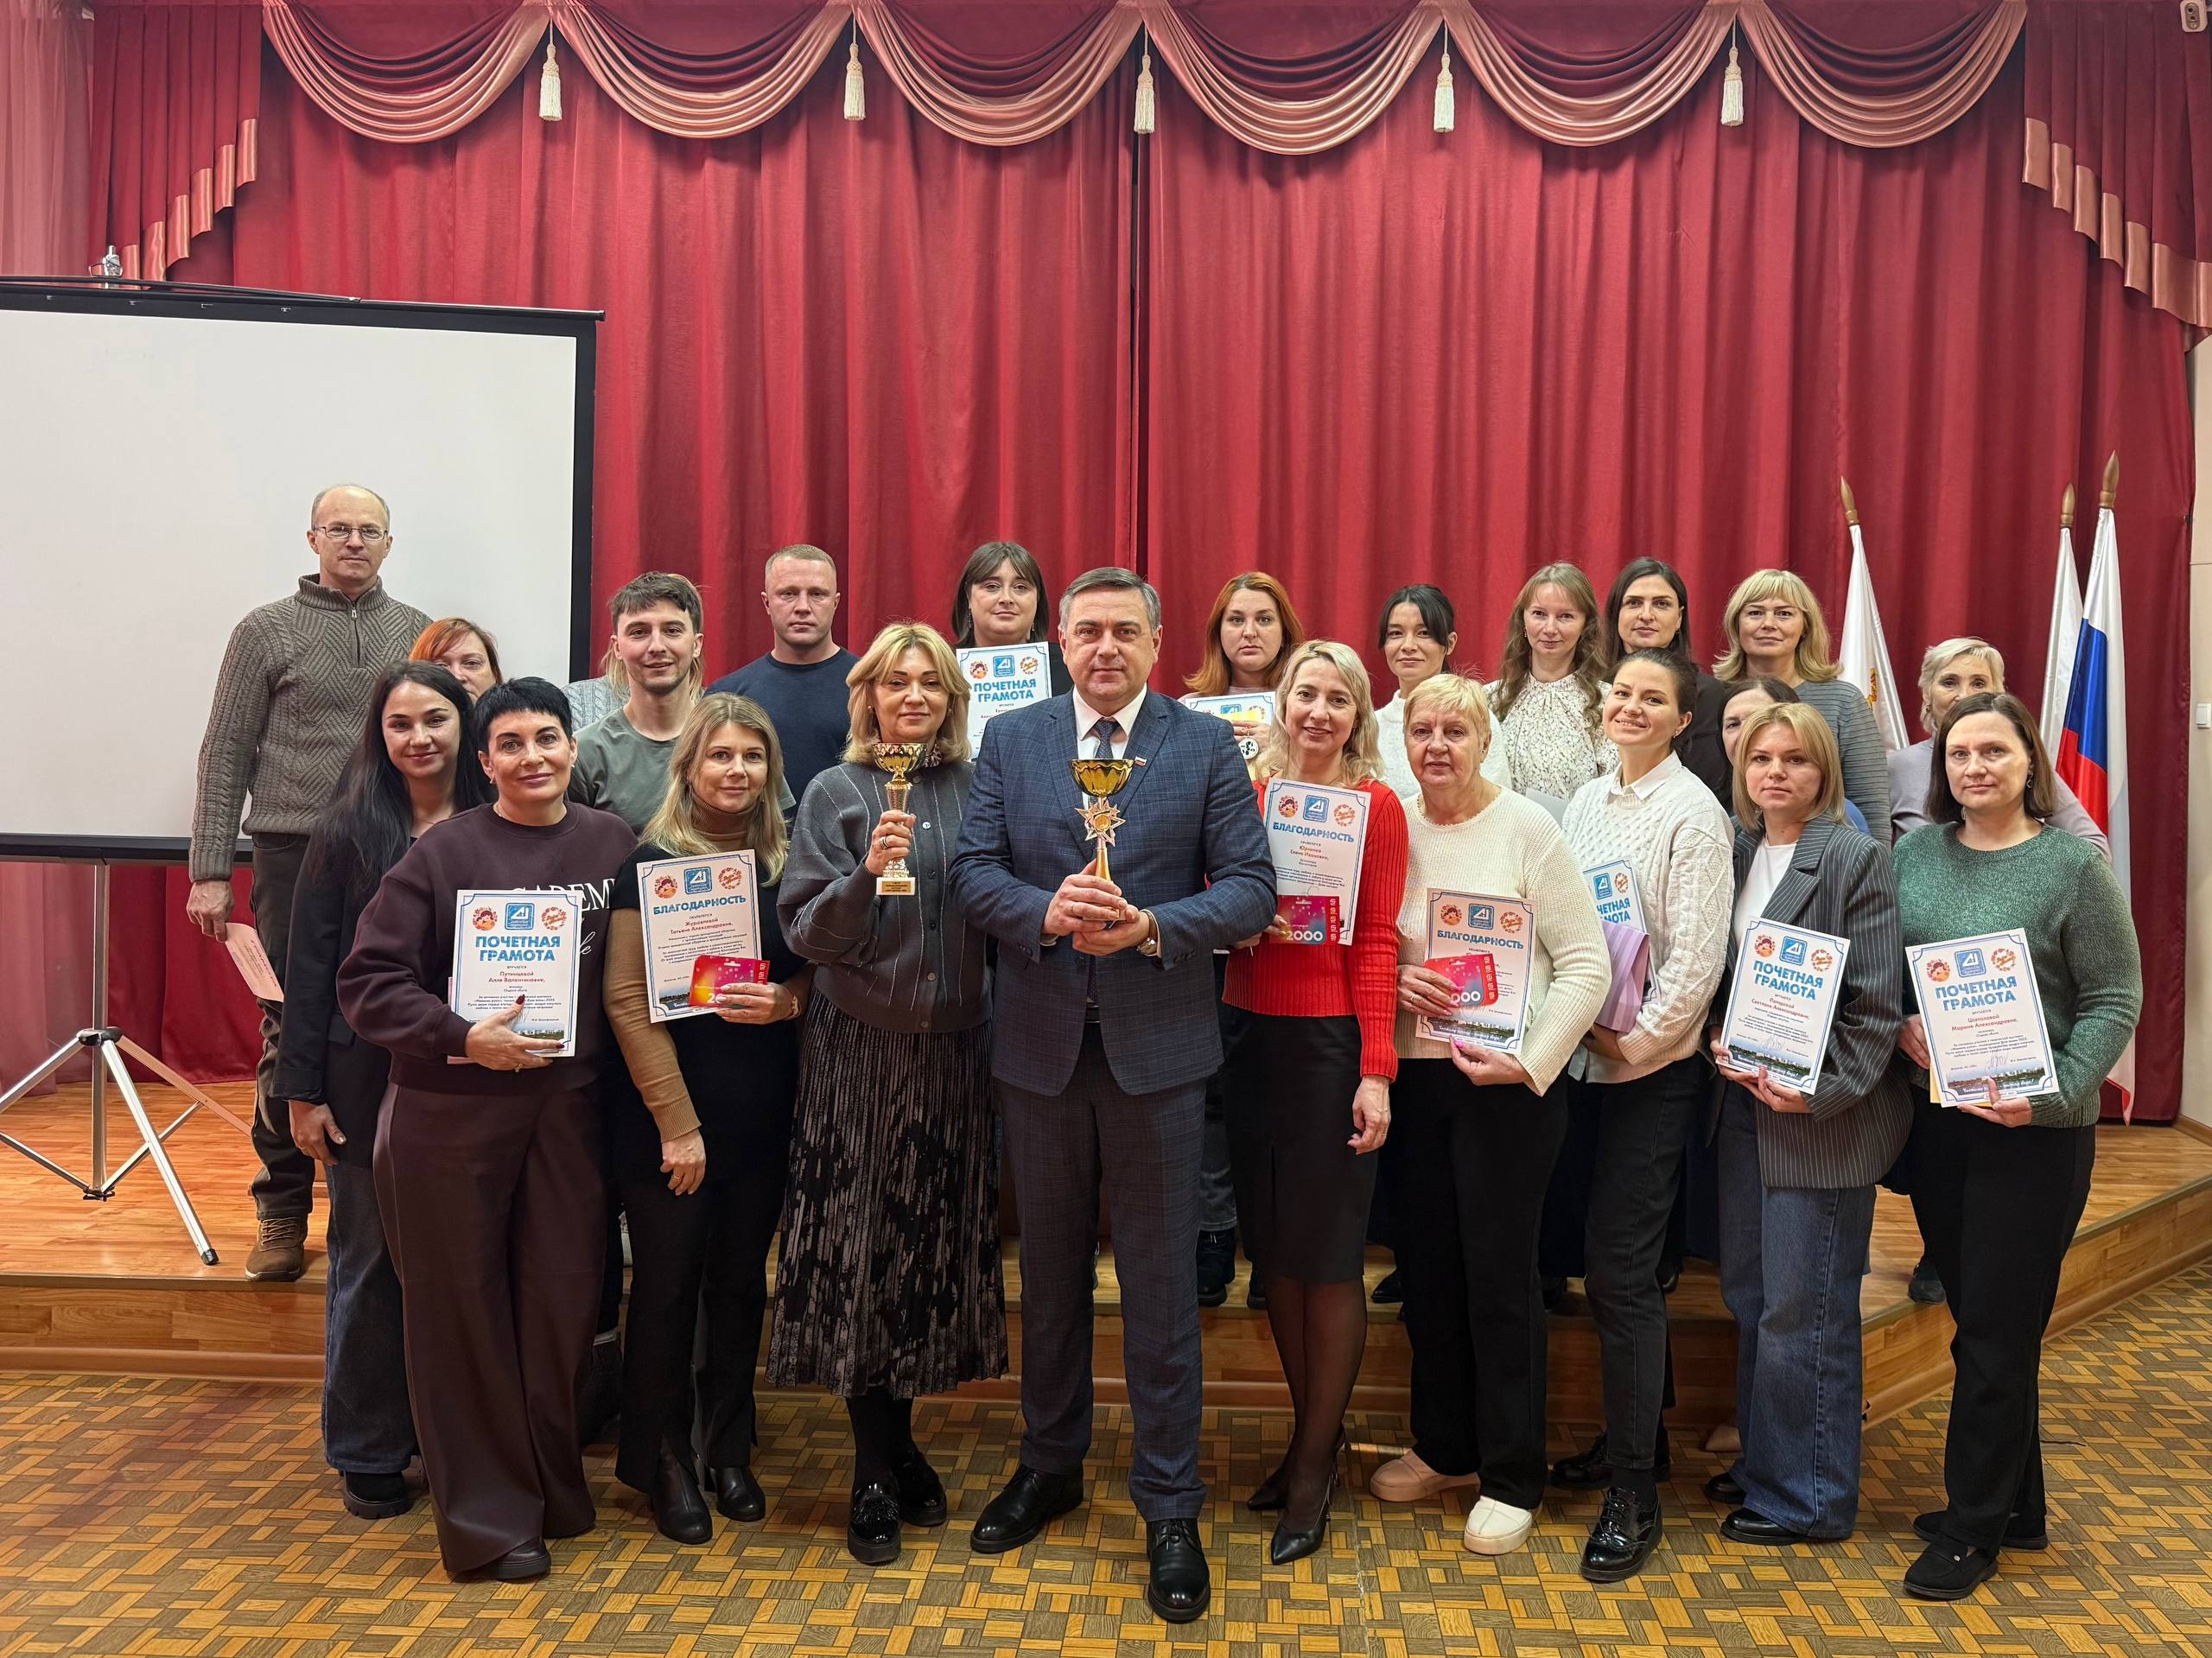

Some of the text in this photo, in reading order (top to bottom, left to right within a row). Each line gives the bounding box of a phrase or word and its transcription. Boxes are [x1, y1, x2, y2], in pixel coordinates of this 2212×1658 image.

[974, 678, 1036, 692] ПОЧЕТНАЯ
[978, 689, 1034, 702] ГРАМОТА
[1273, 822, 1355, 843] БЛАГОДАРНОСТЬ
[652, 895, 747, 916] БЛАГОДАРНОСТЬ
[1596, 897, 1630, 915] ЧЕТНАЯ
[475, 935, 561, 948] ПОЧЕТНАЯ
[1286, 930, 1324, 942] 2000
[1437, 930, 1524, 950] БЛАГОДАРНОСТЬ
[480, 949, 556, 962] ГРАМОТА
[1752, 959, 1824, 989] ПОЧЕТНАЯ
[1754, 973, 1817, 1001] ГРАМОТА
[1935, 975, 2018, 999] ПОЧЕТНАЯ
[1942, 990, 2017, 1012] ГРАМОТА
